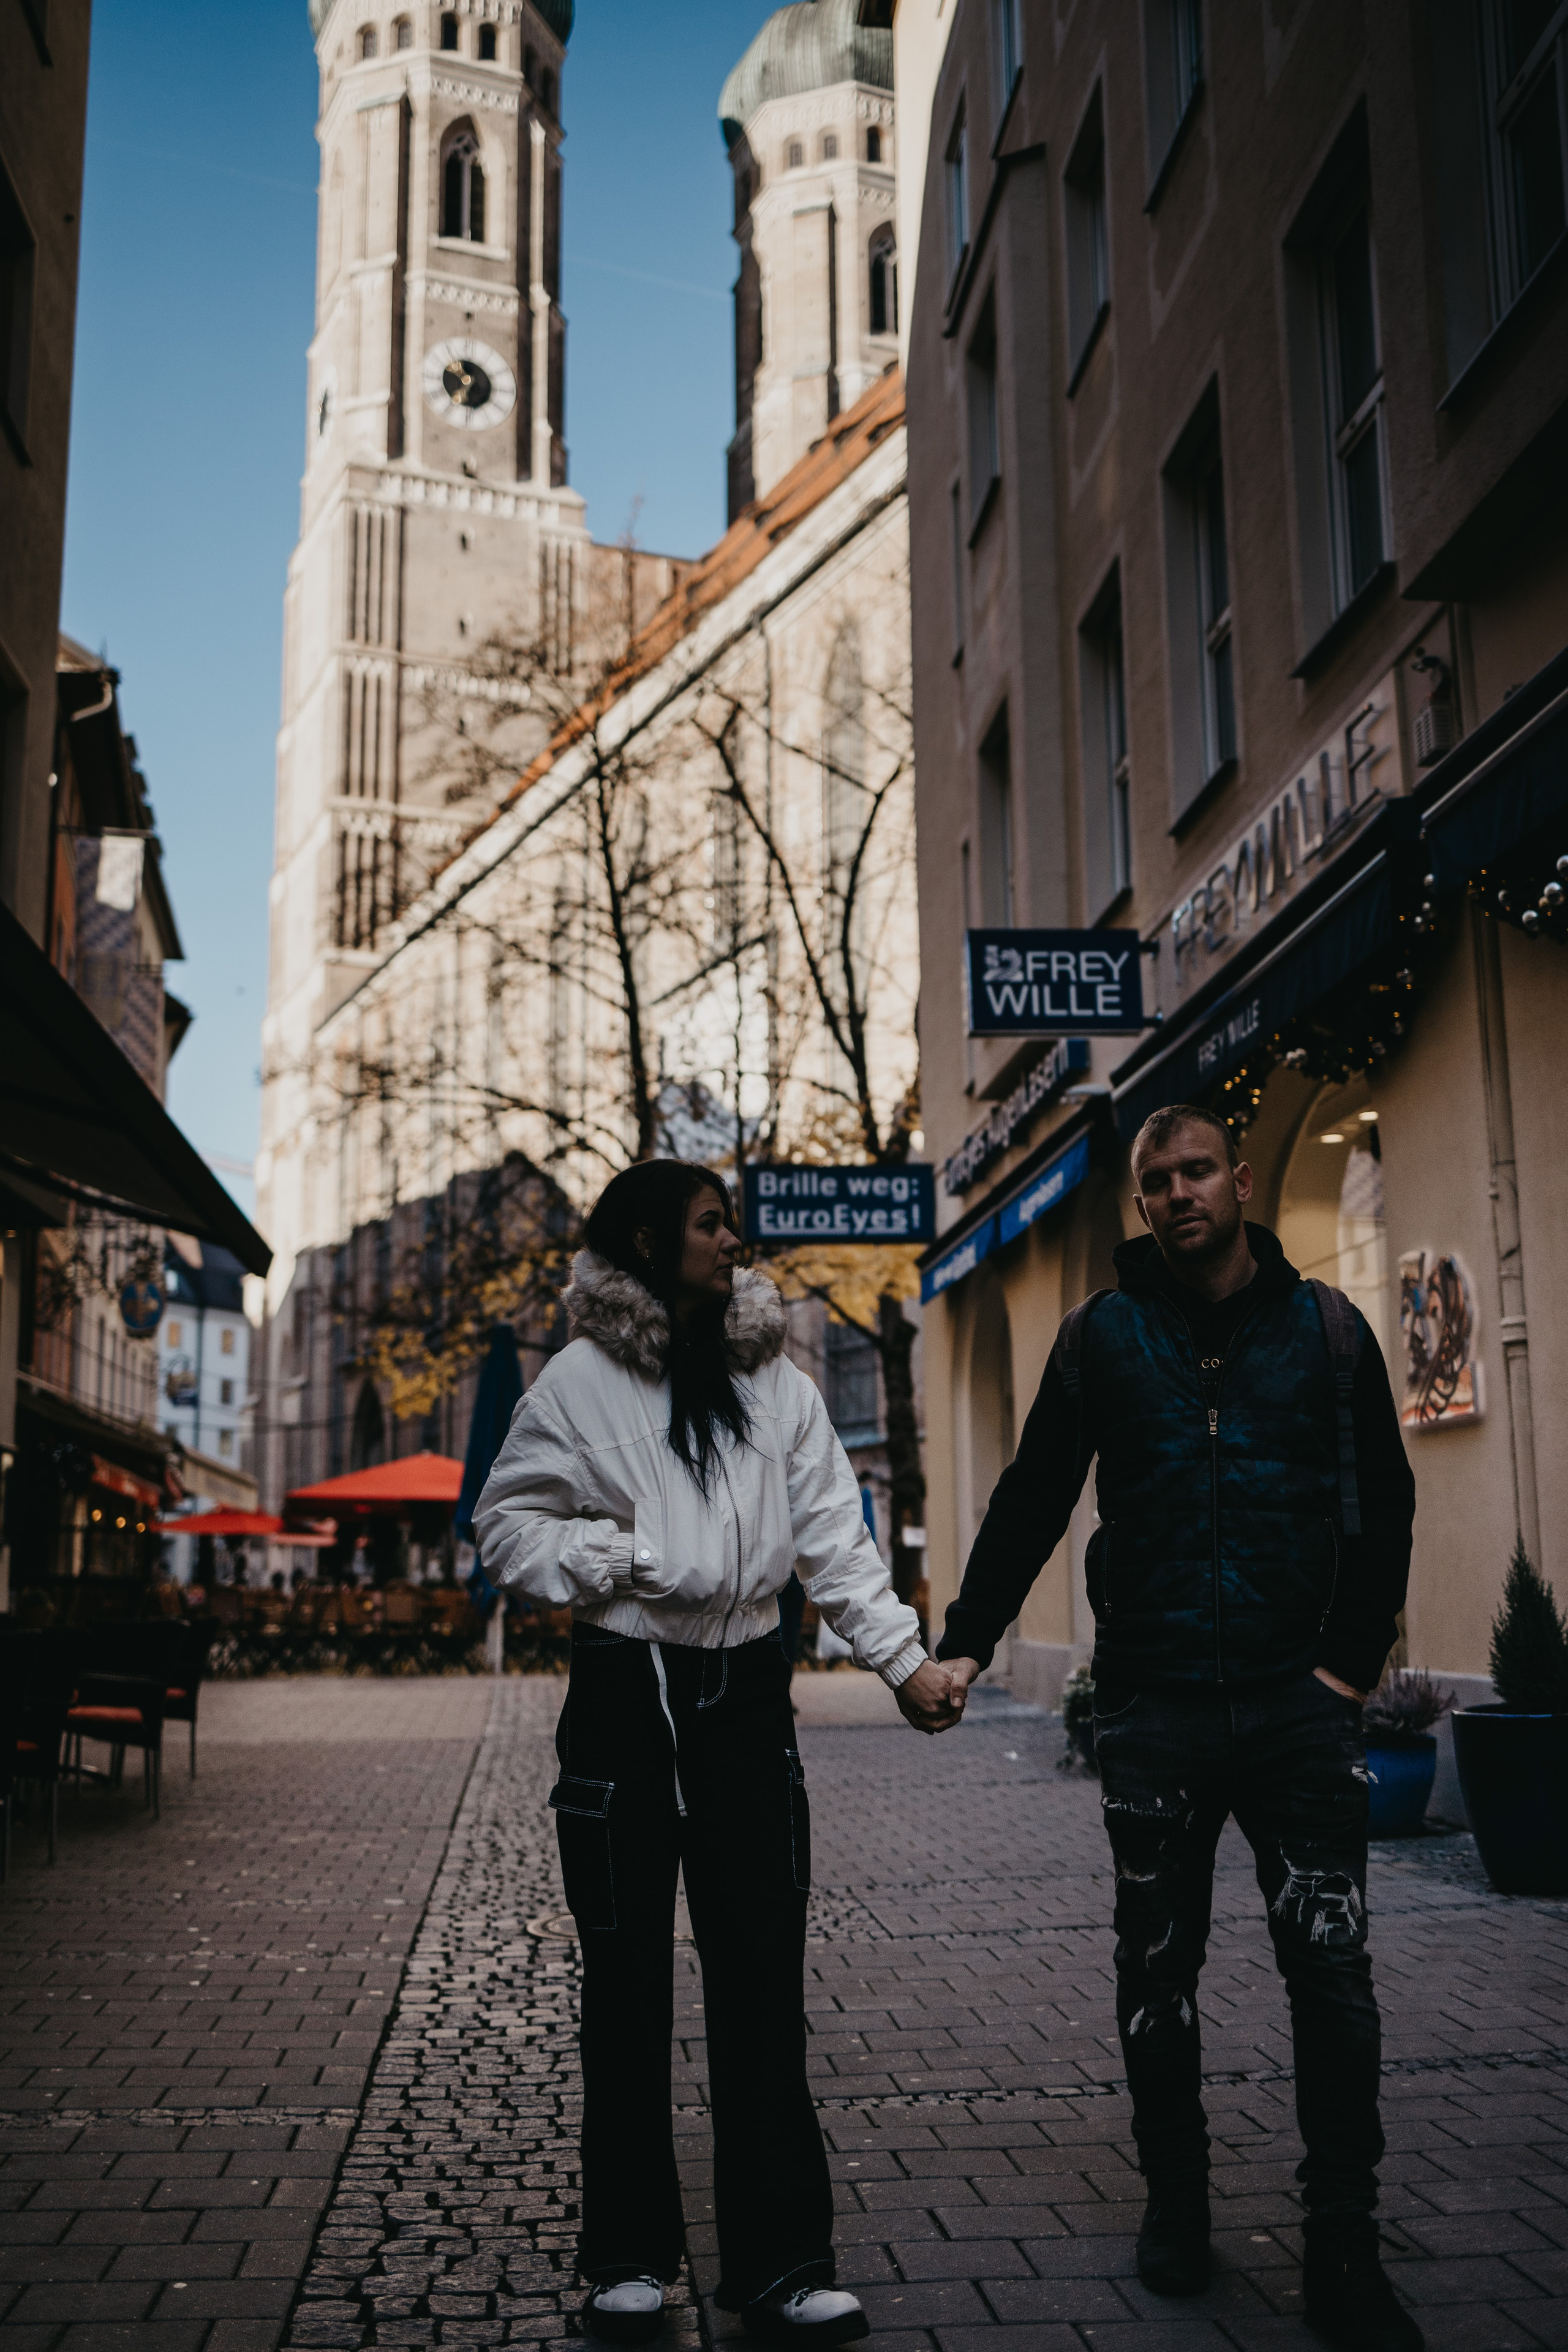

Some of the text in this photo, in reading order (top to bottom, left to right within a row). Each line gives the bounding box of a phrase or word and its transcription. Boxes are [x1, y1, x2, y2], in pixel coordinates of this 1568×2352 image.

[1026, 951, 1130, 982] FREY
[985, 984, 1123, 1017] WILLE
[1199, 998, 1260, 1073] FREY WILLE
[758, 1171, 919, 1203] Brille weg:
[758, 1203, 921, 1235] EuroEyes!
[1201, 1358, 1224, 1369] CO
